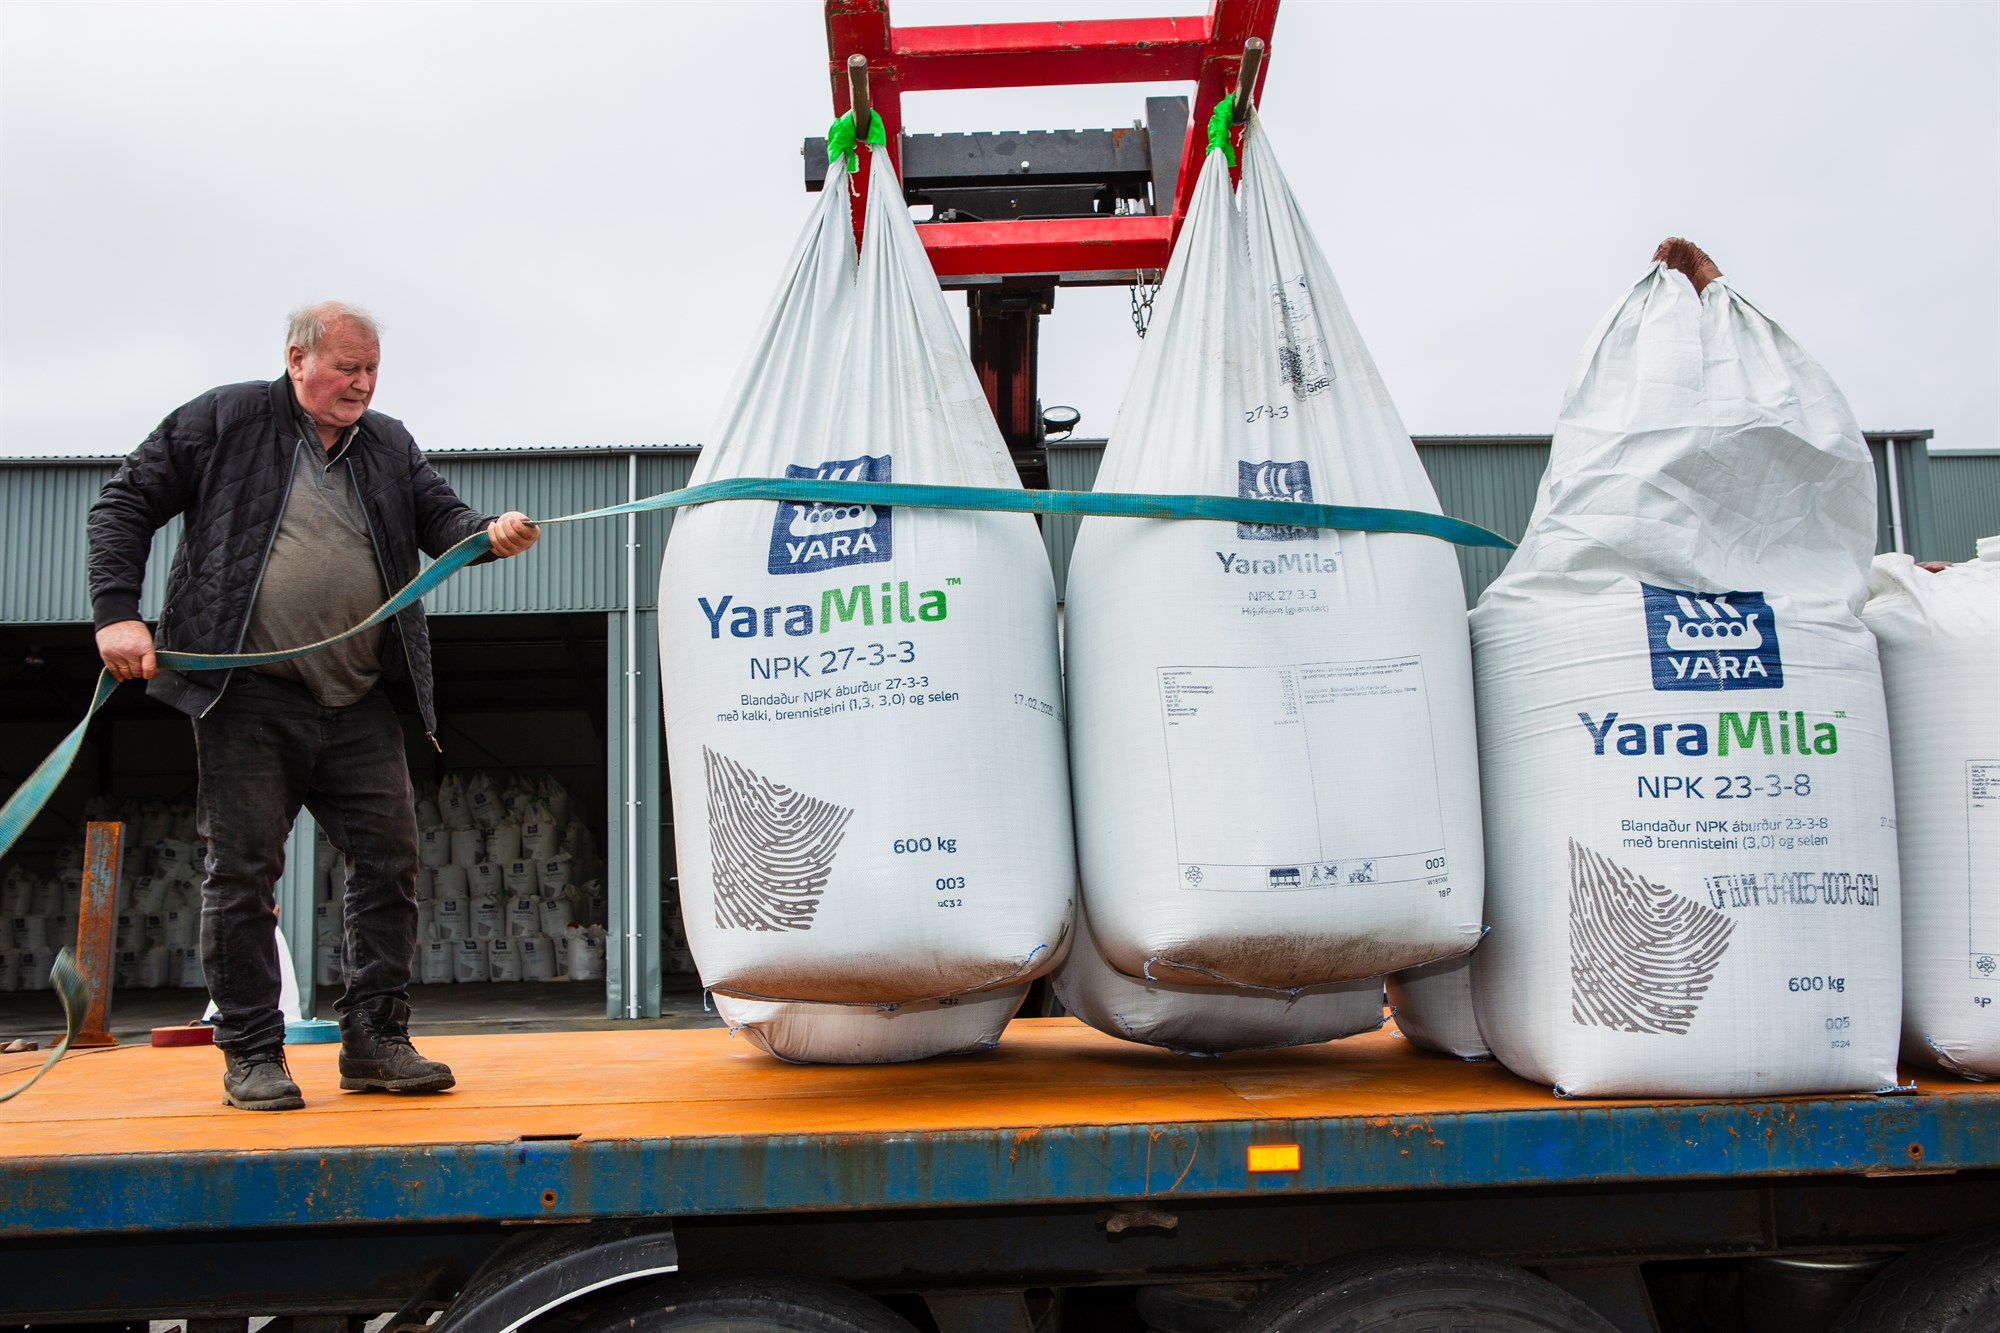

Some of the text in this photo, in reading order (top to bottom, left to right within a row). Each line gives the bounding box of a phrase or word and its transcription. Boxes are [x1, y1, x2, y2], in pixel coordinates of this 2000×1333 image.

[1245, 405, 1290, 423] 27-3-3
[785, 533, 877, 563] YARA
[1248, 589, 1317, 601] NPK 27-3-3
[750, 640, 916, 680] NPK 27-3-3
[1667, 655, 1768, 679] YARA
[741, 676, 929, 706] Blandaður NPK áburður 27-3-3
[717, 709, 739, 722] með
[742, 708, 772, 722] kalki,
[775, 702, 845, 721] brennisteini
[909, 694, 925, 706] og
[928, 691, 959, 703] selen
[1637, 773, 1812, 799] NPK 23-3-8
[1621, 817, 1829, 832] Blandaður NPK áburður 23-3-8
[893, 836, 957, 855] 600 kg
[1623, 836, 1653, 848] með
[1657, 837, 1738, 849] brennisteini
[1778, 837, 1794, 849] og
[1797, 835, 1828, 846] selen
[1425, 856, 1445, 870] 003
[936, 876, 965, 891] 003
[1788, 975, 1845, 993] 600 kg
[1825, 1016, 1850, 1030] 005
